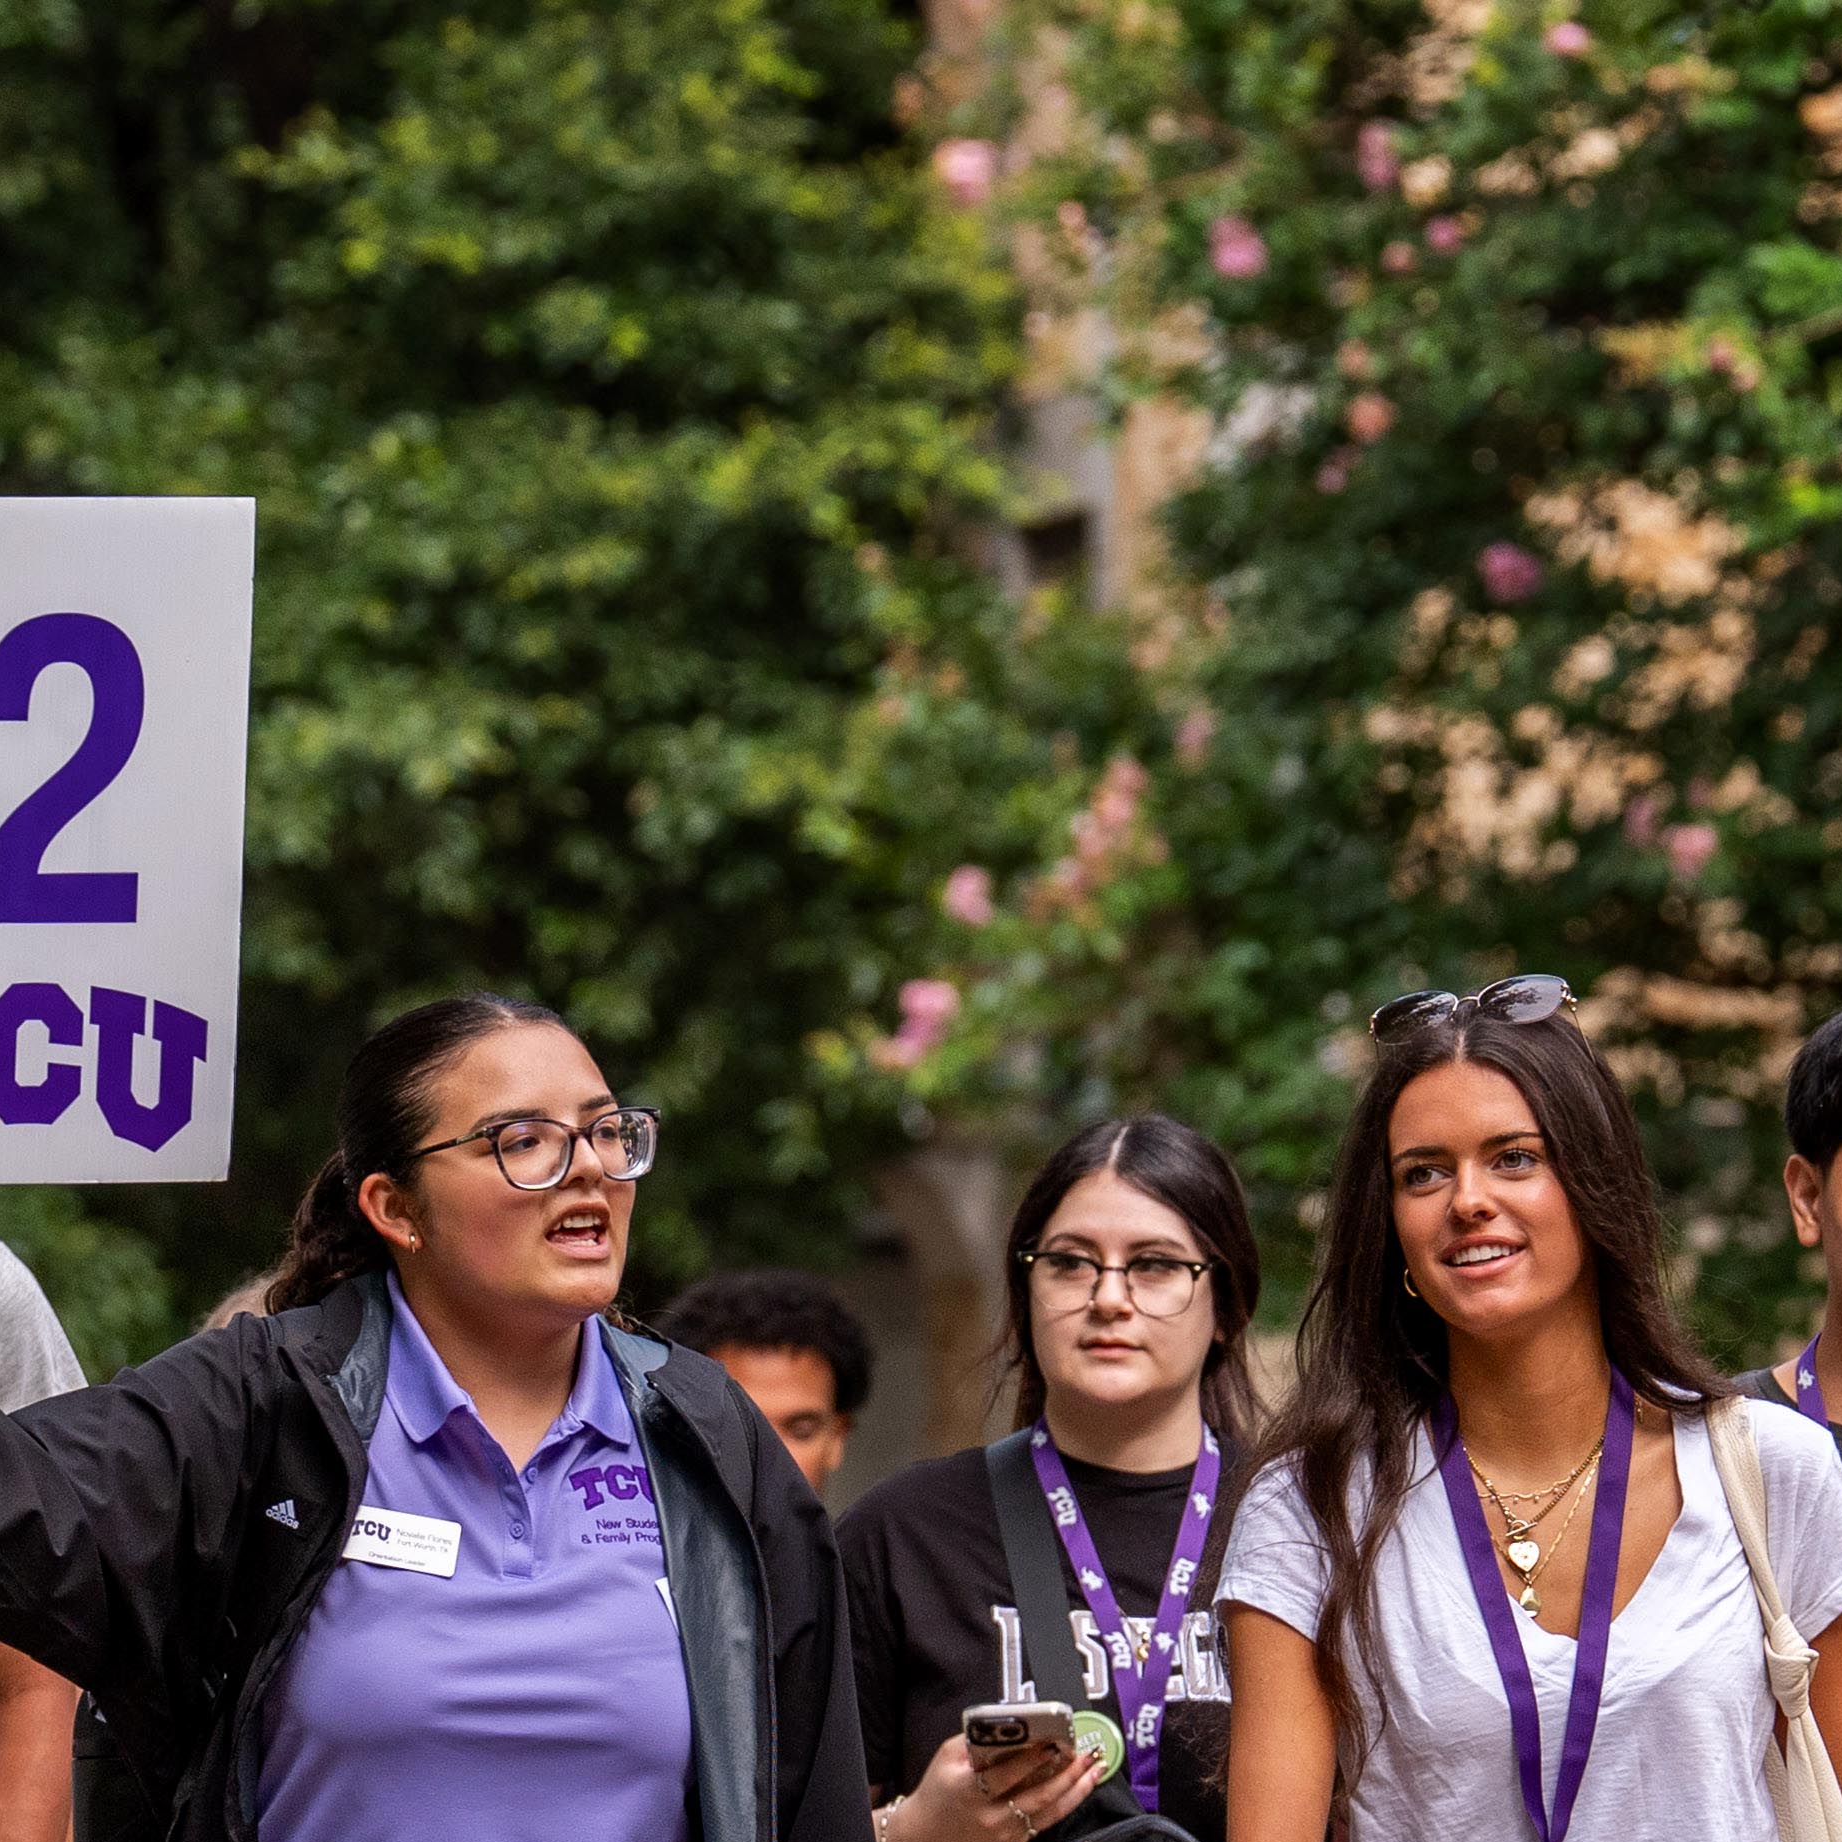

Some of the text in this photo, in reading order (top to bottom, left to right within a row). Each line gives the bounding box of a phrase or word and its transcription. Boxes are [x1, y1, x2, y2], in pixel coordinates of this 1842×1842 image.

[265, 1508, 300, 1530] adidas
[596, 1519, 621, 1530] New
[1046, 1486, 1078, 1526] TCU
[352, 1519, 391, 1541] TCU
[1169, 1557, 1197, 1596] TCU
[990, 1603, 1109, 1702] LS
[1104, 1630, 1132, 1669] TCU
[1135, 1703, 1162, 1749] TCU
